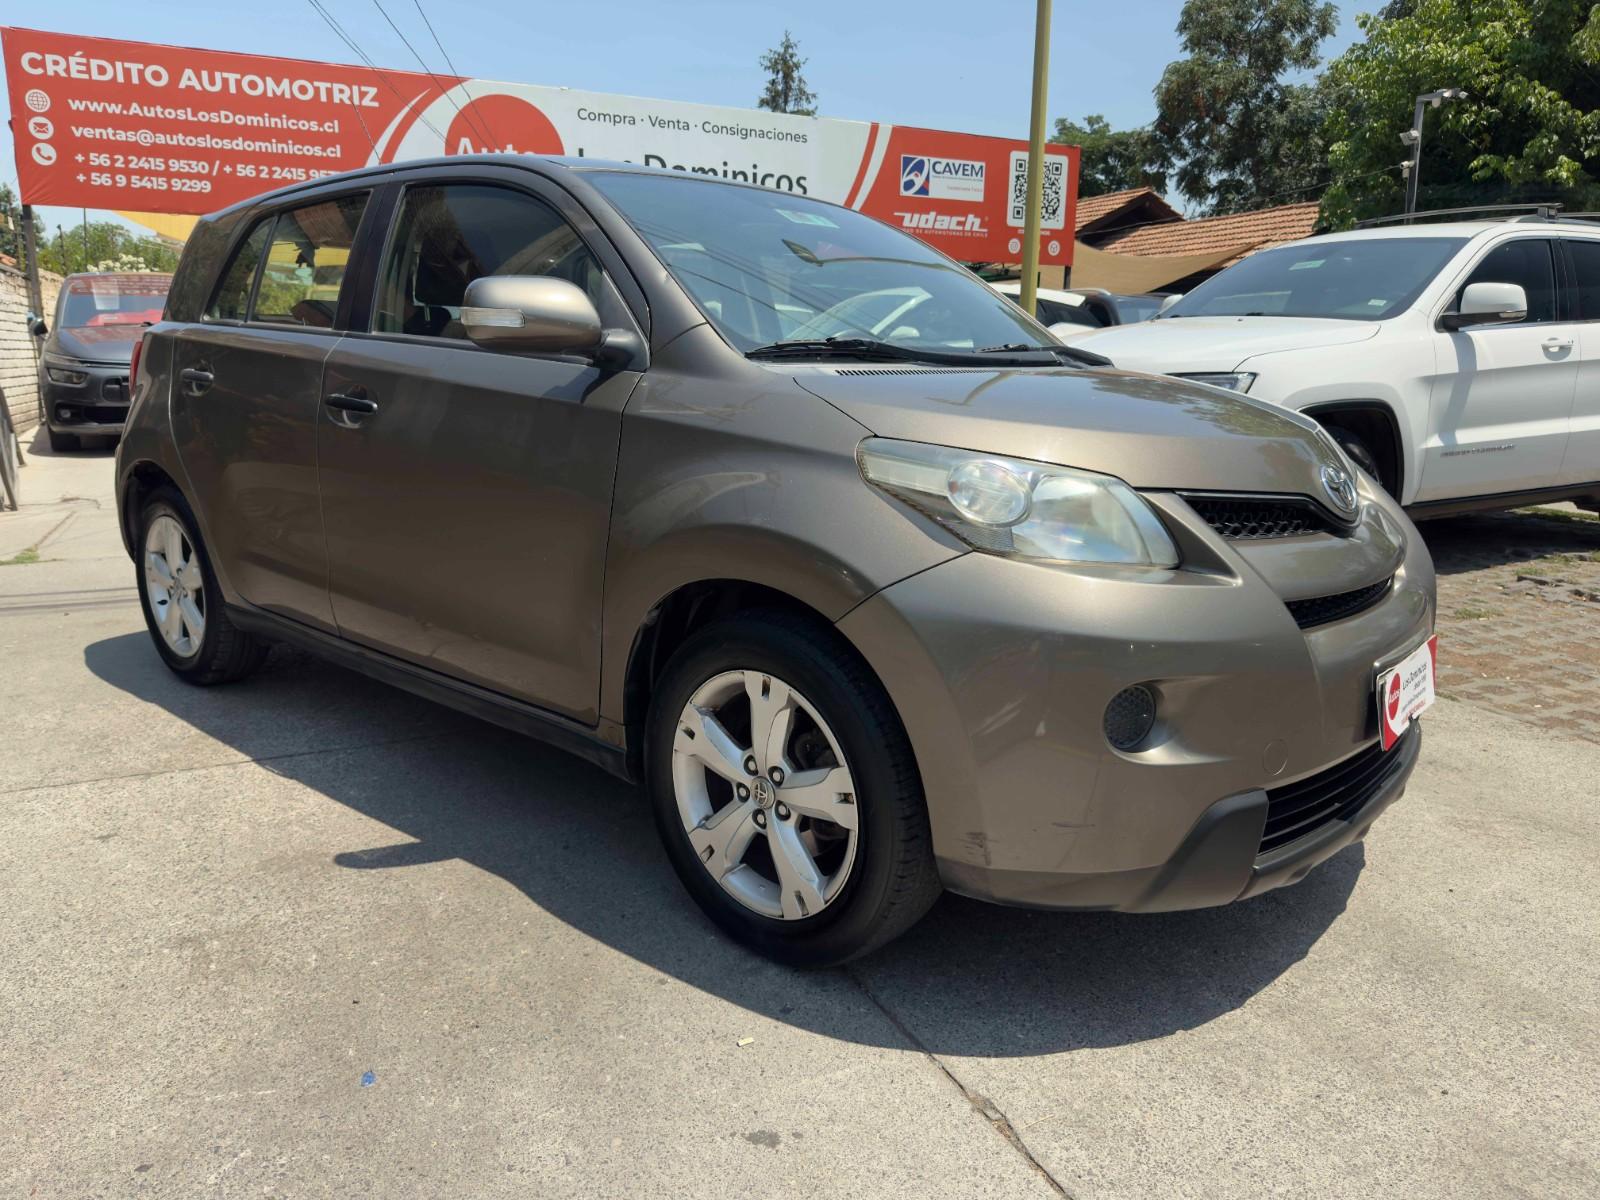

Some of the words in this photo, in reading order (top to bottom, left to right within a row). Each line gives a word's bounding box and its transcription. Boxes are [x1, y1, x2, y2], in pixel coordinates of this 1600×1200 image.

[20, 51, 169, 87] CRÉDITO
[178, 68, 379, 107] AUTOMOTRIZ
[67, 98, 339, 133] www.AutosLosDominicos.cl
[577, 108, 636, 126] Compra
[648, 115, 690, 131] Venta
[701, 121, 808, 143] Consignaciones
[71, 125, 341, 158] ventas@autoslosdominicos.cl
[89, 152, 111, 167] 56
[113, 155, 125, 168] 2
[128, 155, 165, 171] 2415
[168, 159, 209, 174] 9530
[236, 164, 256, 177] 56
[258, 166, 270, 179] 2
[272, 166, 306, 181] 2415
[90, 172, 112, 186] 56
[115, 174, 127, 187] 9
[131, 175, 168, 190] 5415
[170, 178, 212, 193] 9299
[932, 161, 984, 178] CAVEM
